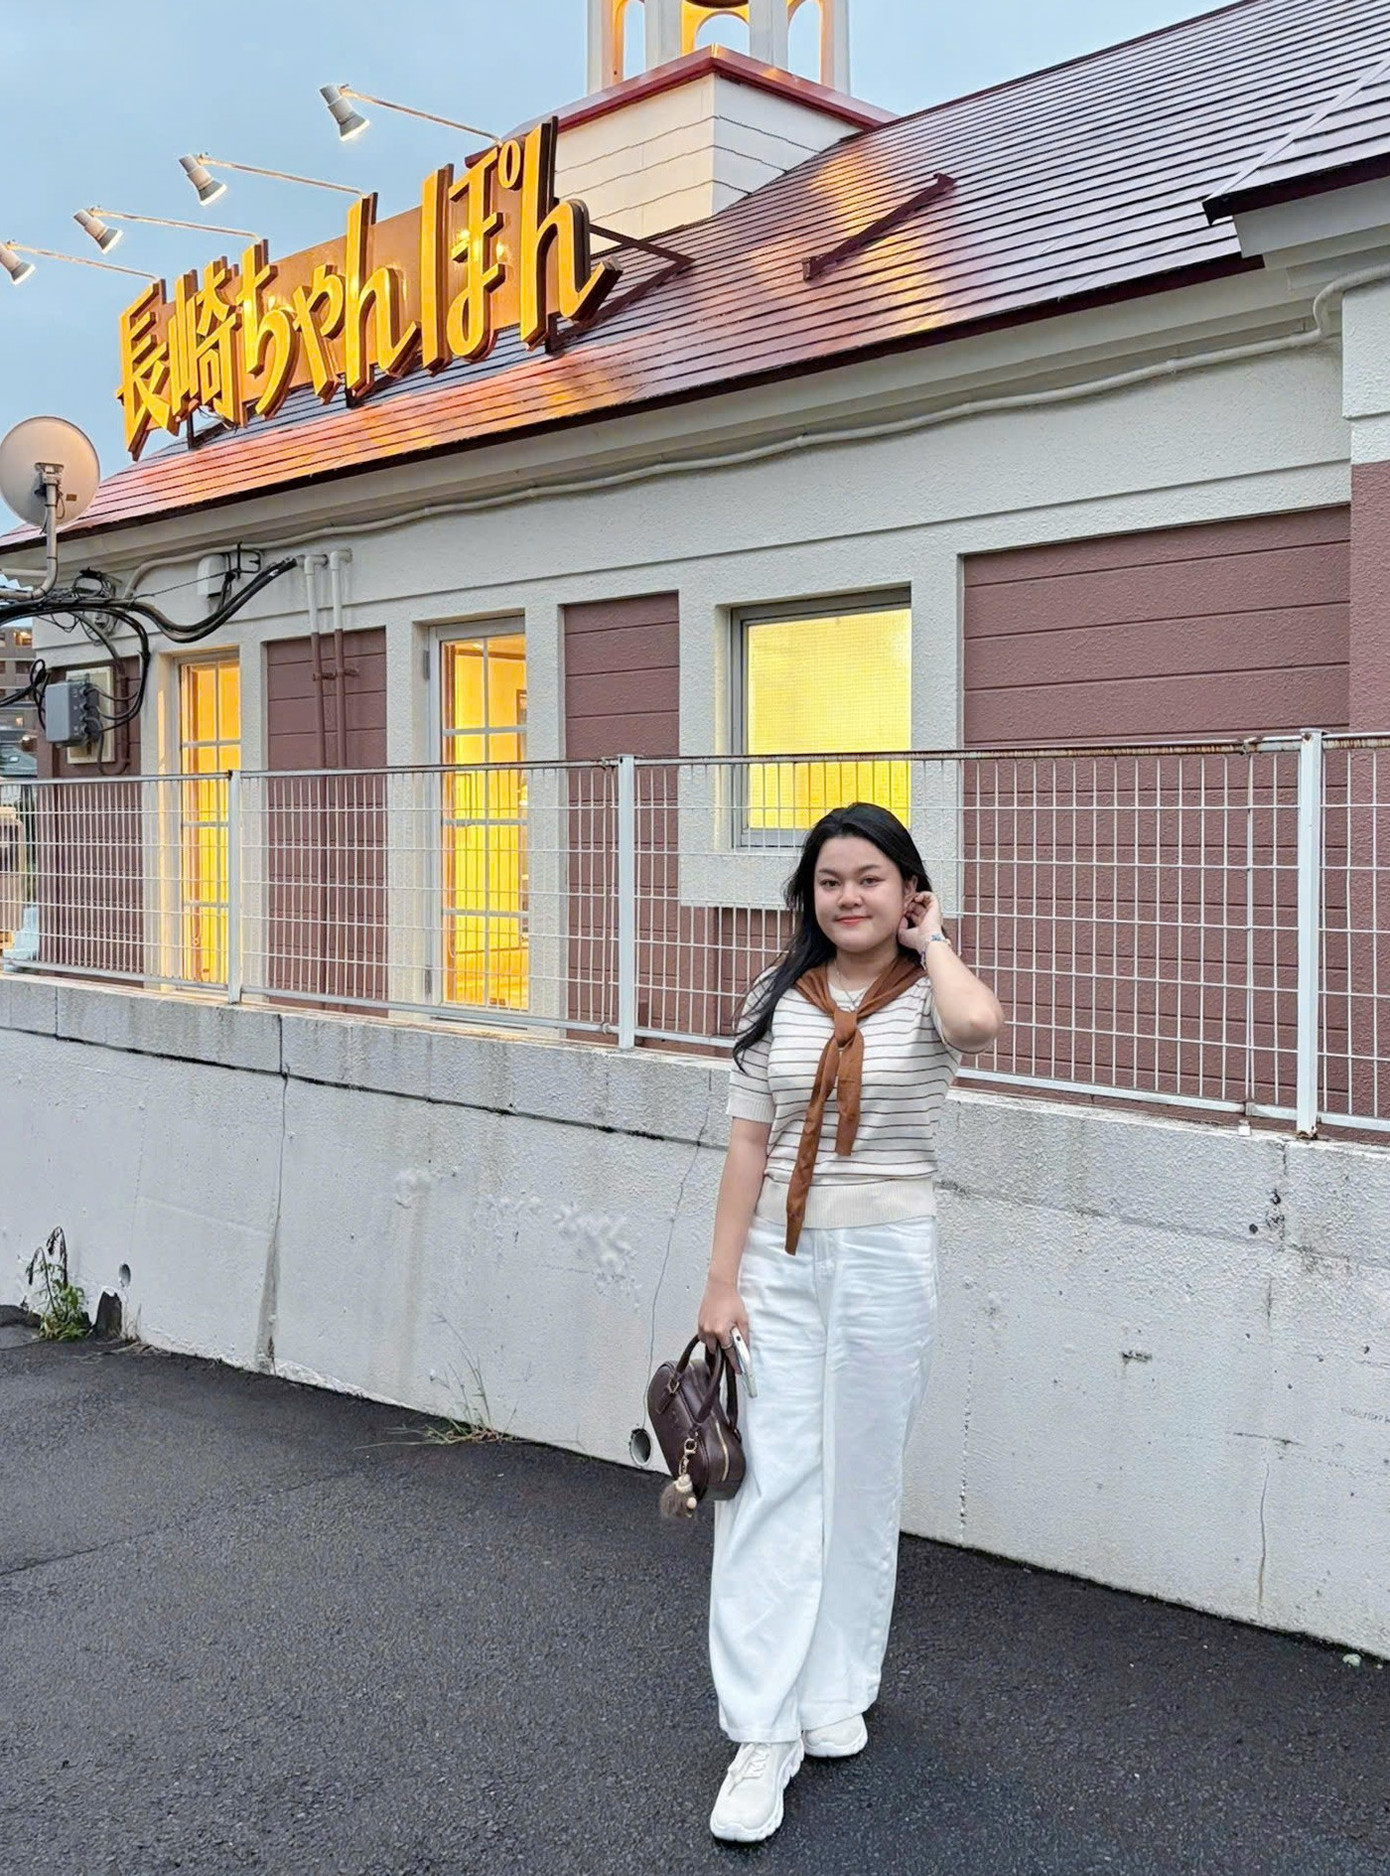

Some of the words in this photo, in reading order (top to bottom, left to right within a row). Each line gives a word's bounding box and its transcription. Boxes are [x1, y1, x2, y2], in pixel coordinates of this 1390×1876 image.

[117, 119, 621, 459] 長崎ちゃんぽん
